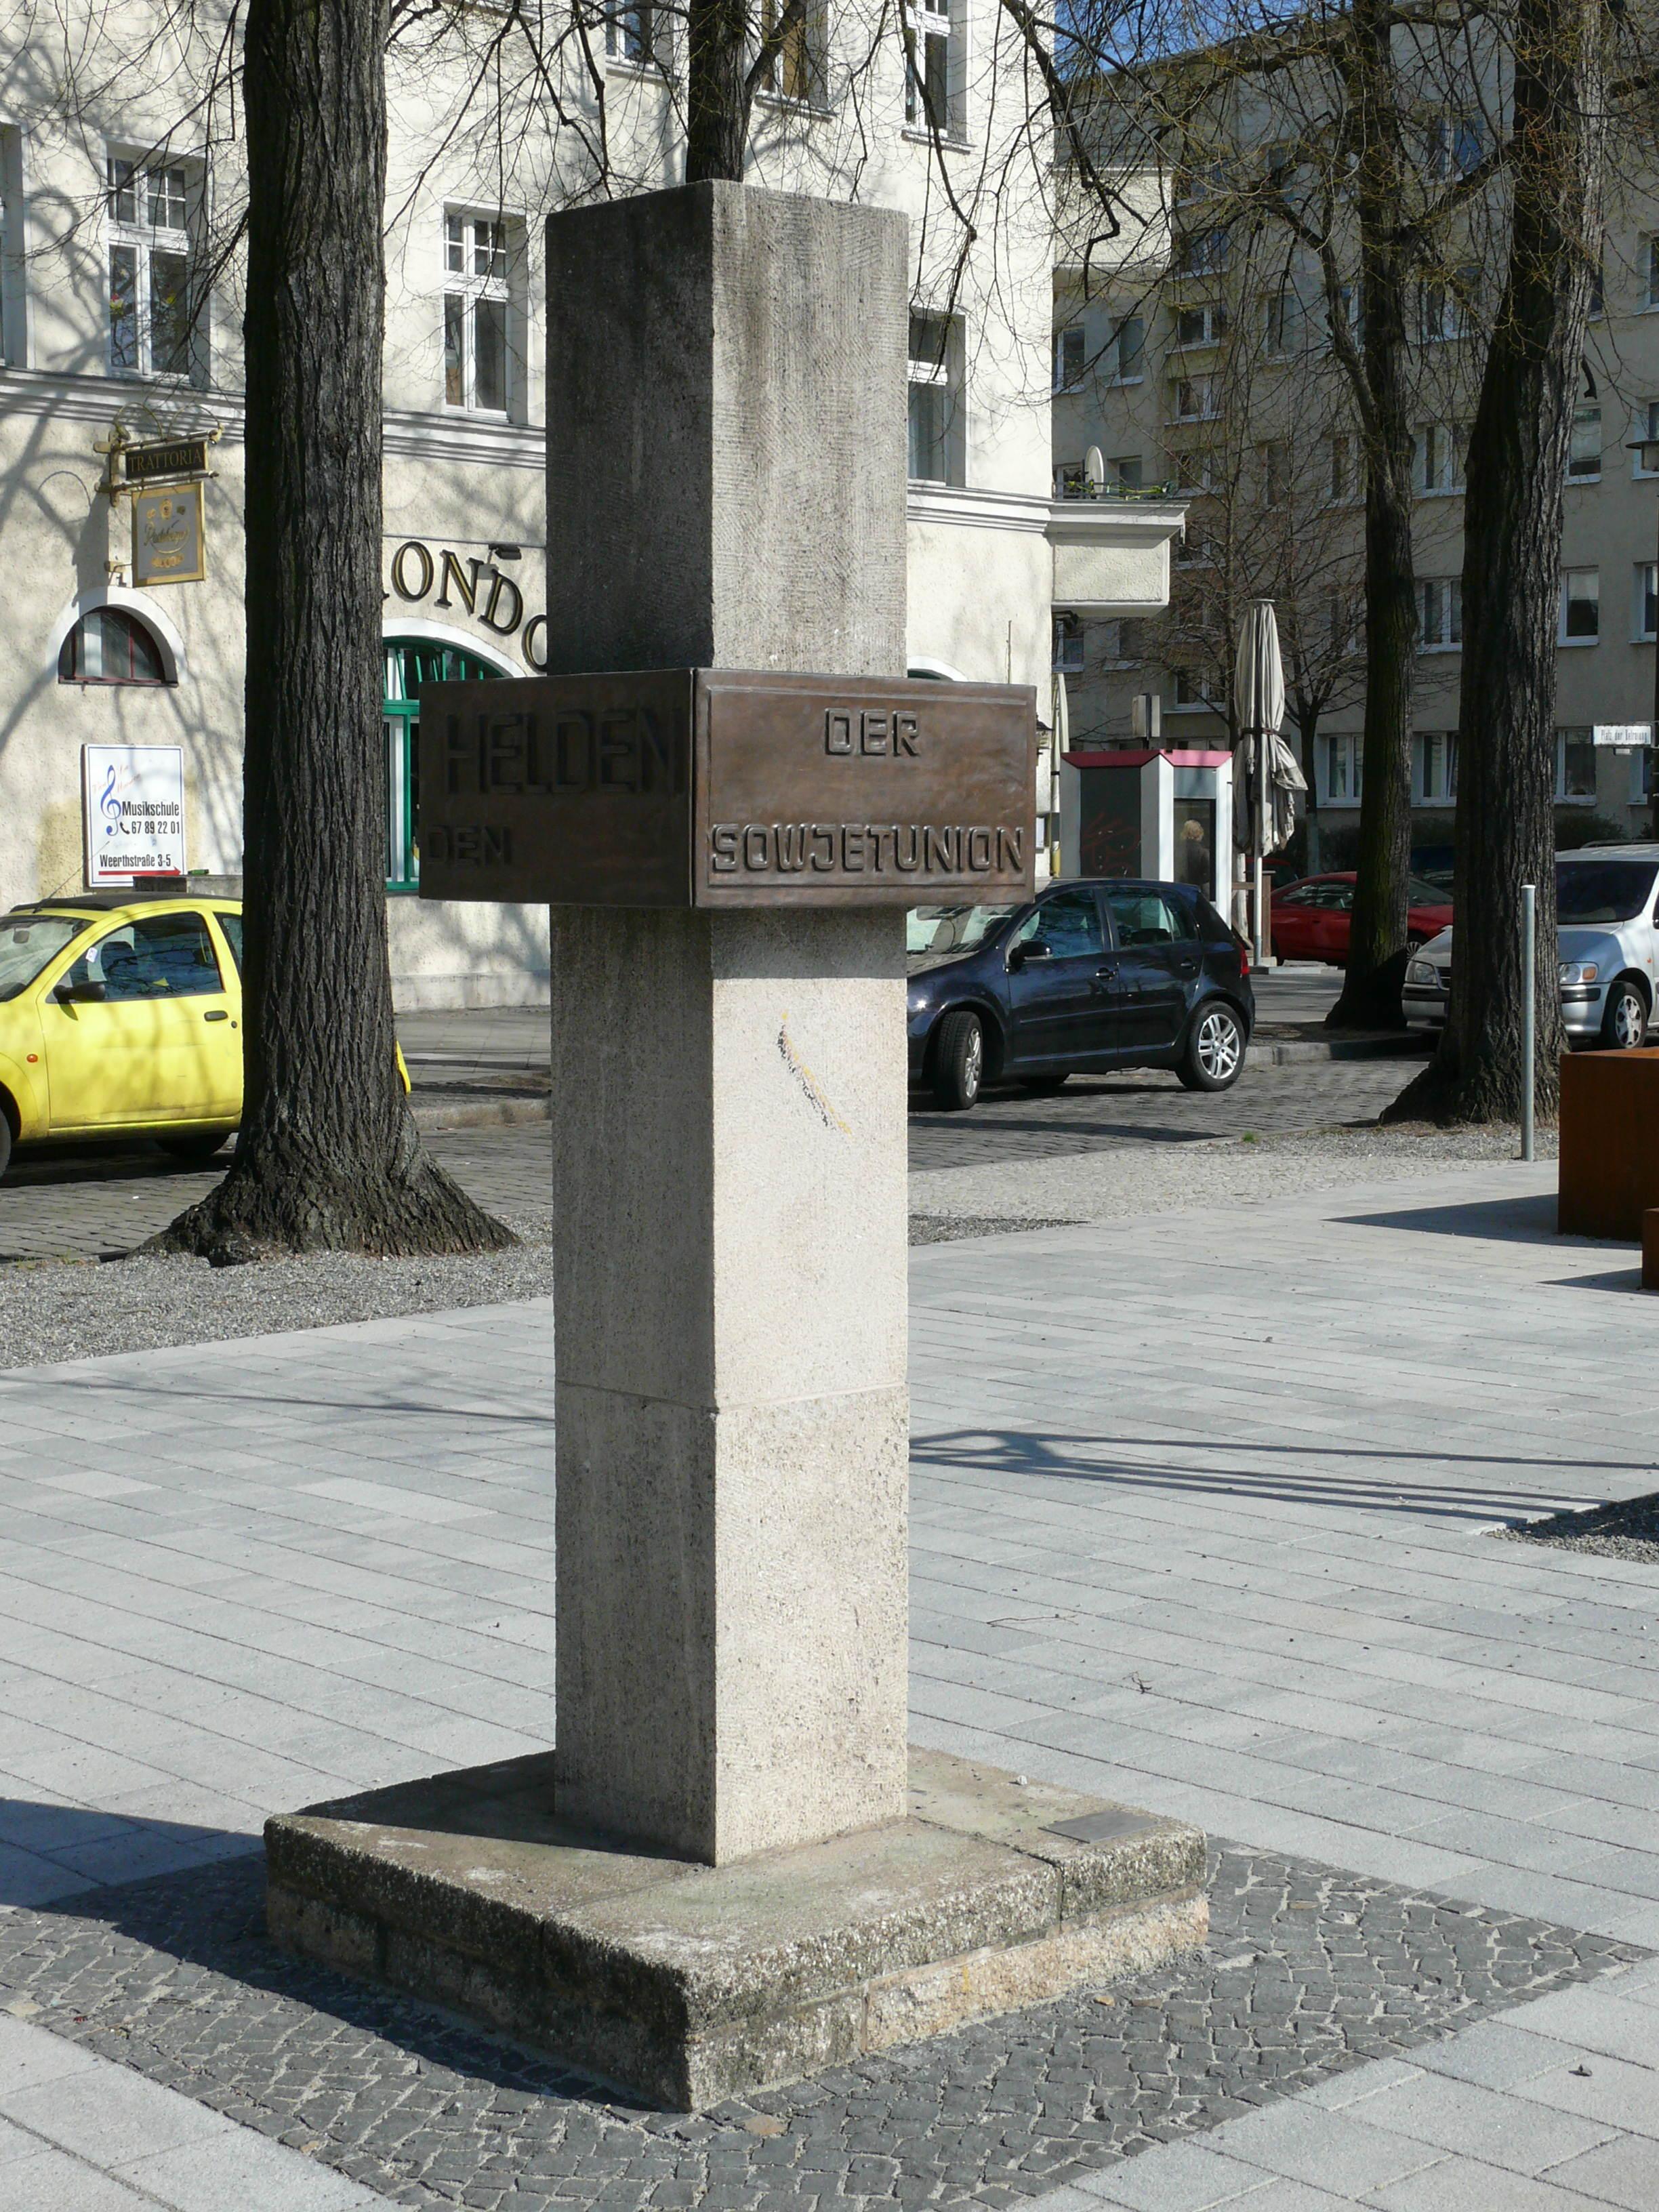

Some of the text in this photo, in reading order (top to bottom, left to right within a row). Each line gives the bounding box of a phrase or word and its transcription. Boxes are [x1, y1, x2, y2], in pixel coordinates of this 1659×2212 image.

[128, 448, 202, 472] TRATTORIA
[824, 707, 920, 756] DER
[444, 707, 685, 794] HELDEN
[122, 801, 180, 816] Musikschule
[131, 821, 180, 834] 67 89 22 01
[100, 853, 171, 868] Weerthstraße 3-5
[427, 823, 513, 866] DEN
[712, 823, 1025, 873] SOWJETUNION
